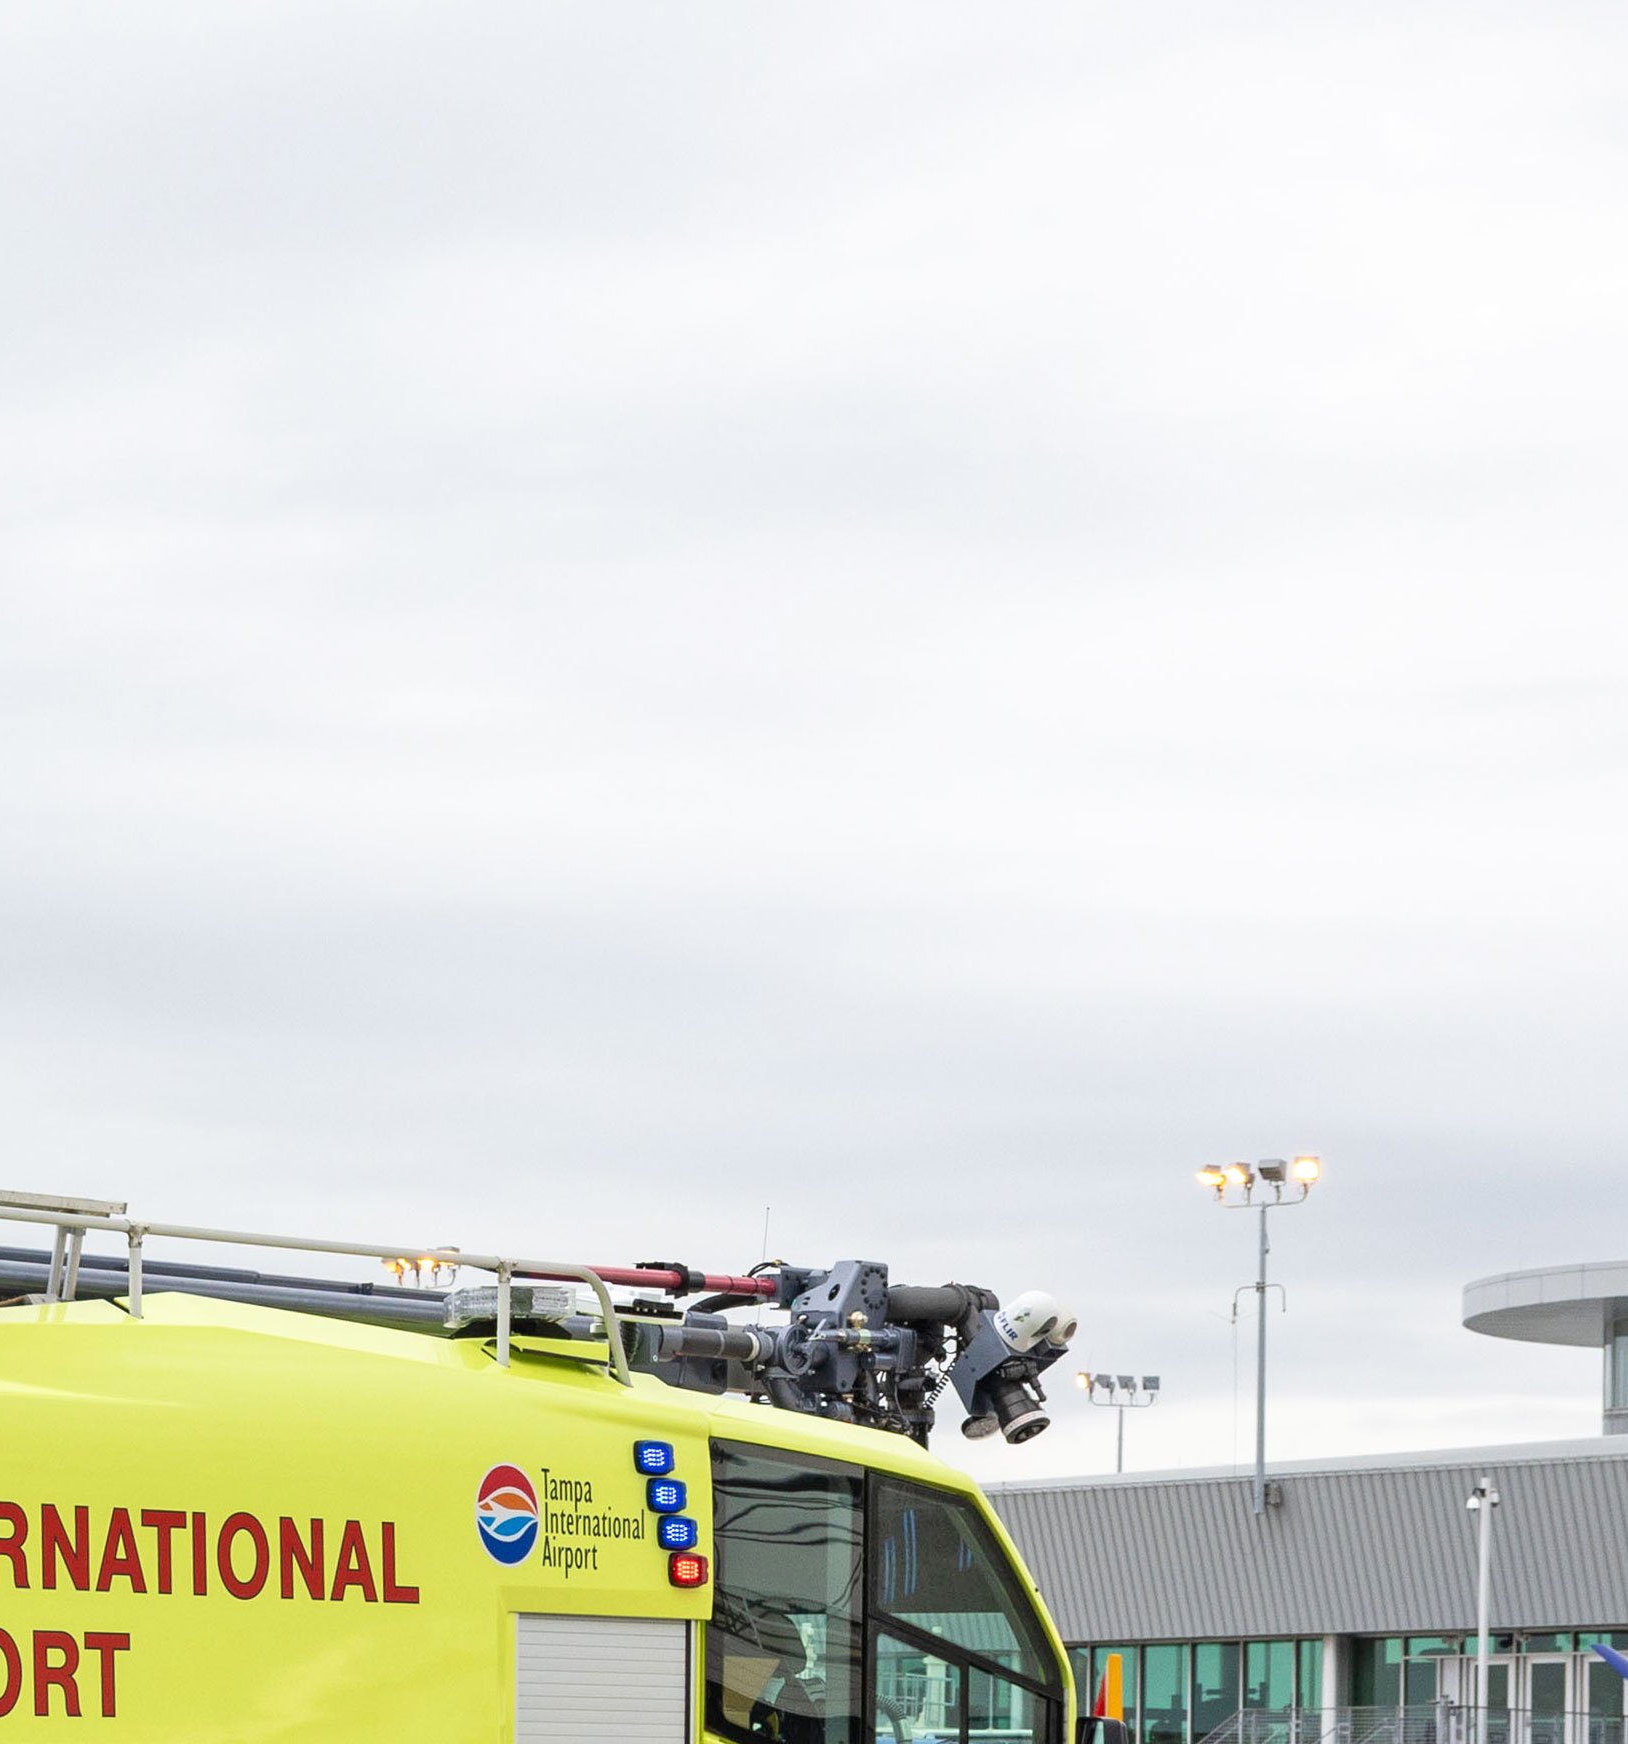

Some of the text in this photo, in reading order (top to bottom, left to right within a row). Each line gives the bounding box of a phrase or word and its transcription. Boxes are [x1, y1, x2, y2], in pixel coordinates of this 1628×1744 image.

[541, 1468, 593, 1513] Tampa
[544, 1502, 645, 1540] International
[542, 1535, 598, 1579] Airport
